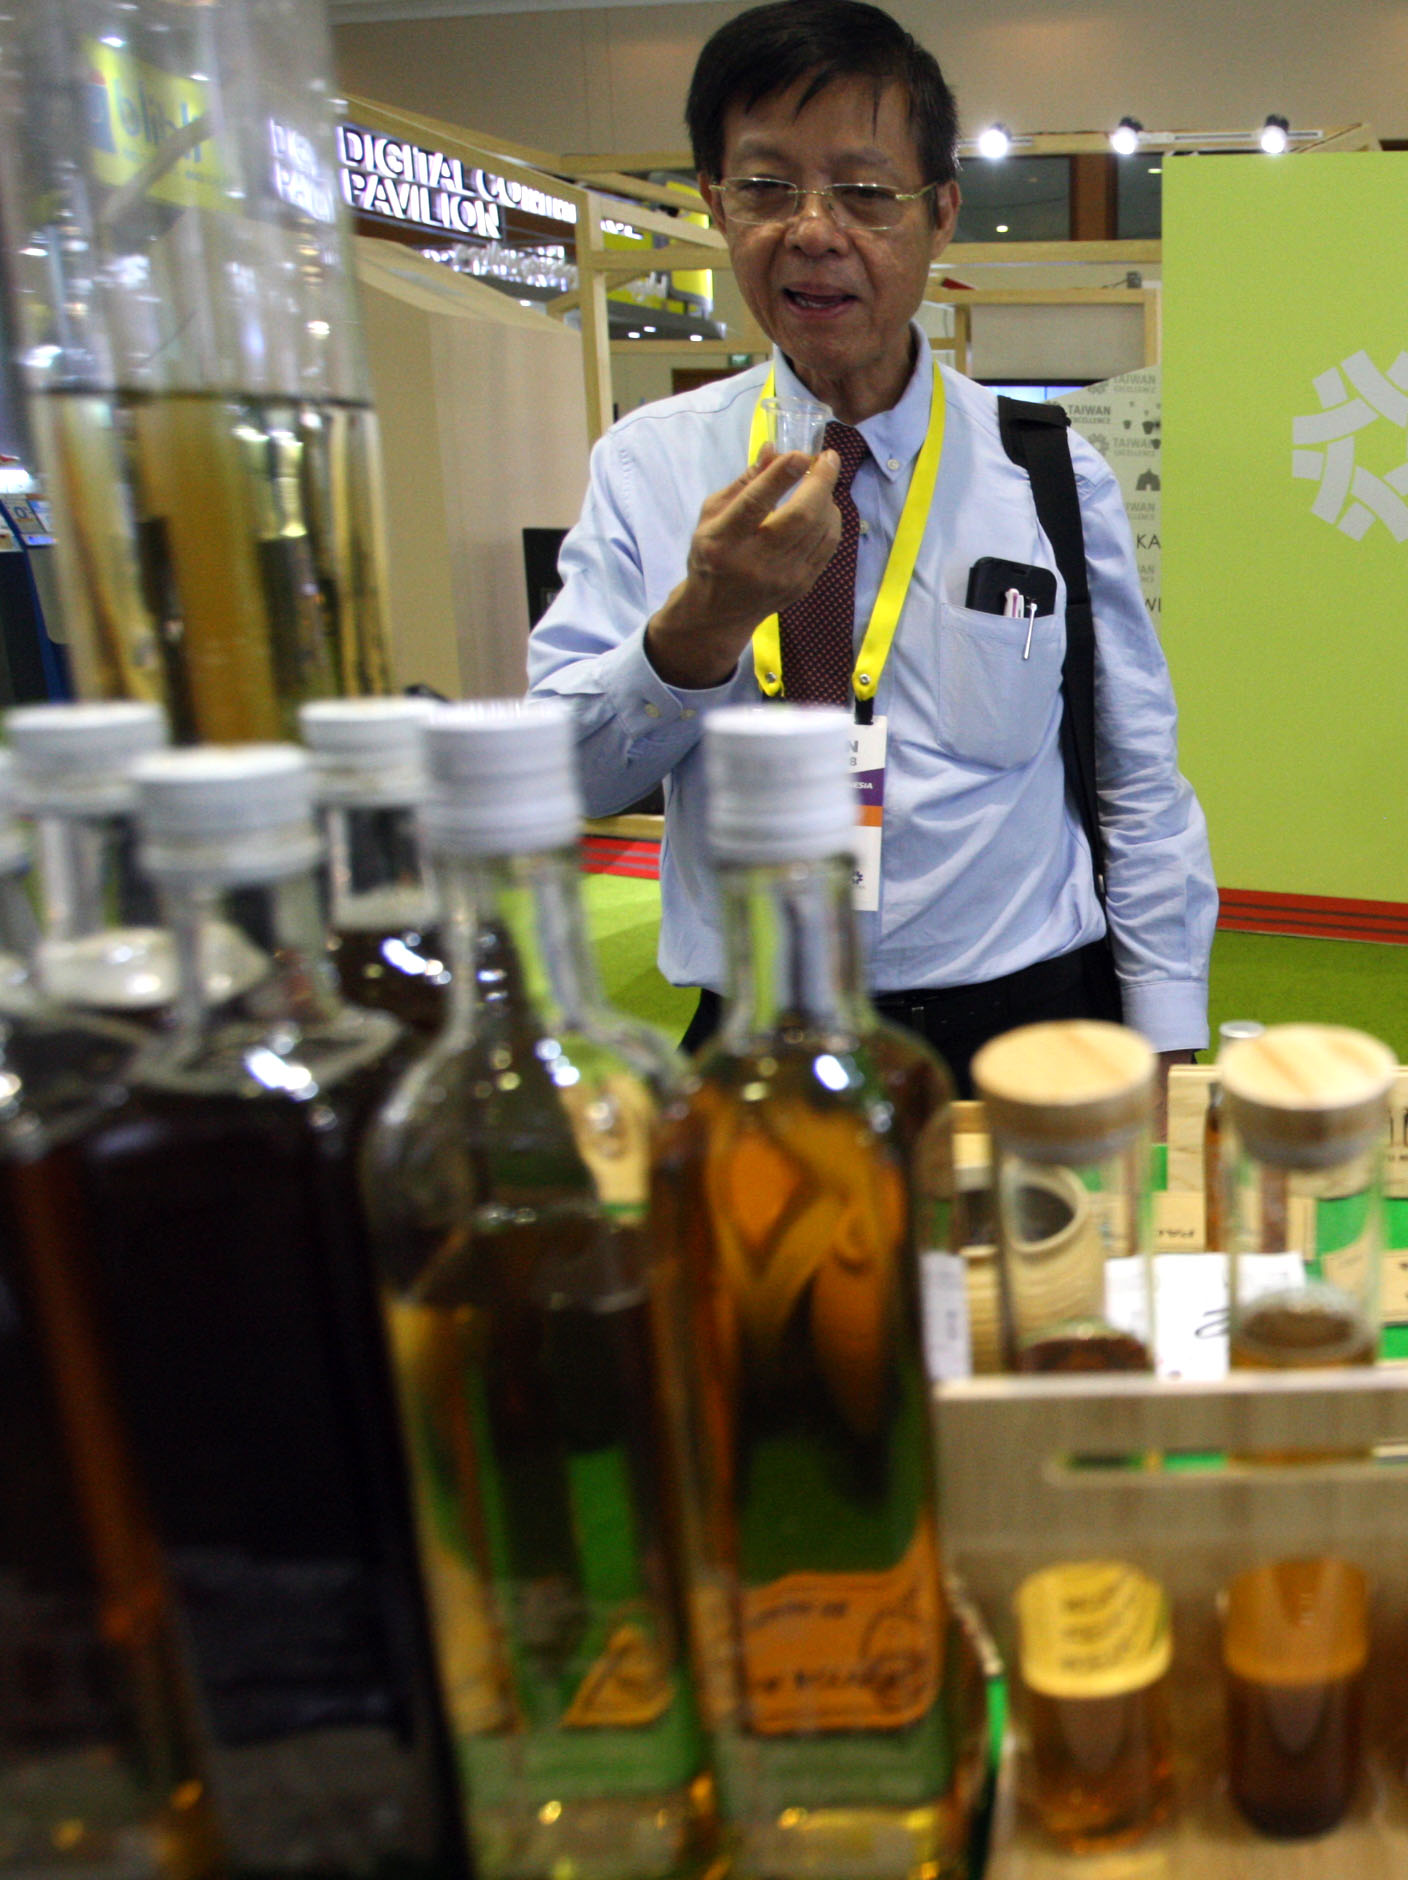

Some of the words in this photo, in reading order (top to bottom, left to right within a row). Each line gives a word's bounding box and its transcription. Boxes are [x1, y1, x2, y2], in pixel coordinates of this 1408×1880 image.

[336, 125, 477, 197] DIGITAL
[340, 167, 501, 240] PAVILION
[1068, 404, 1111, 416] TAIWAN
